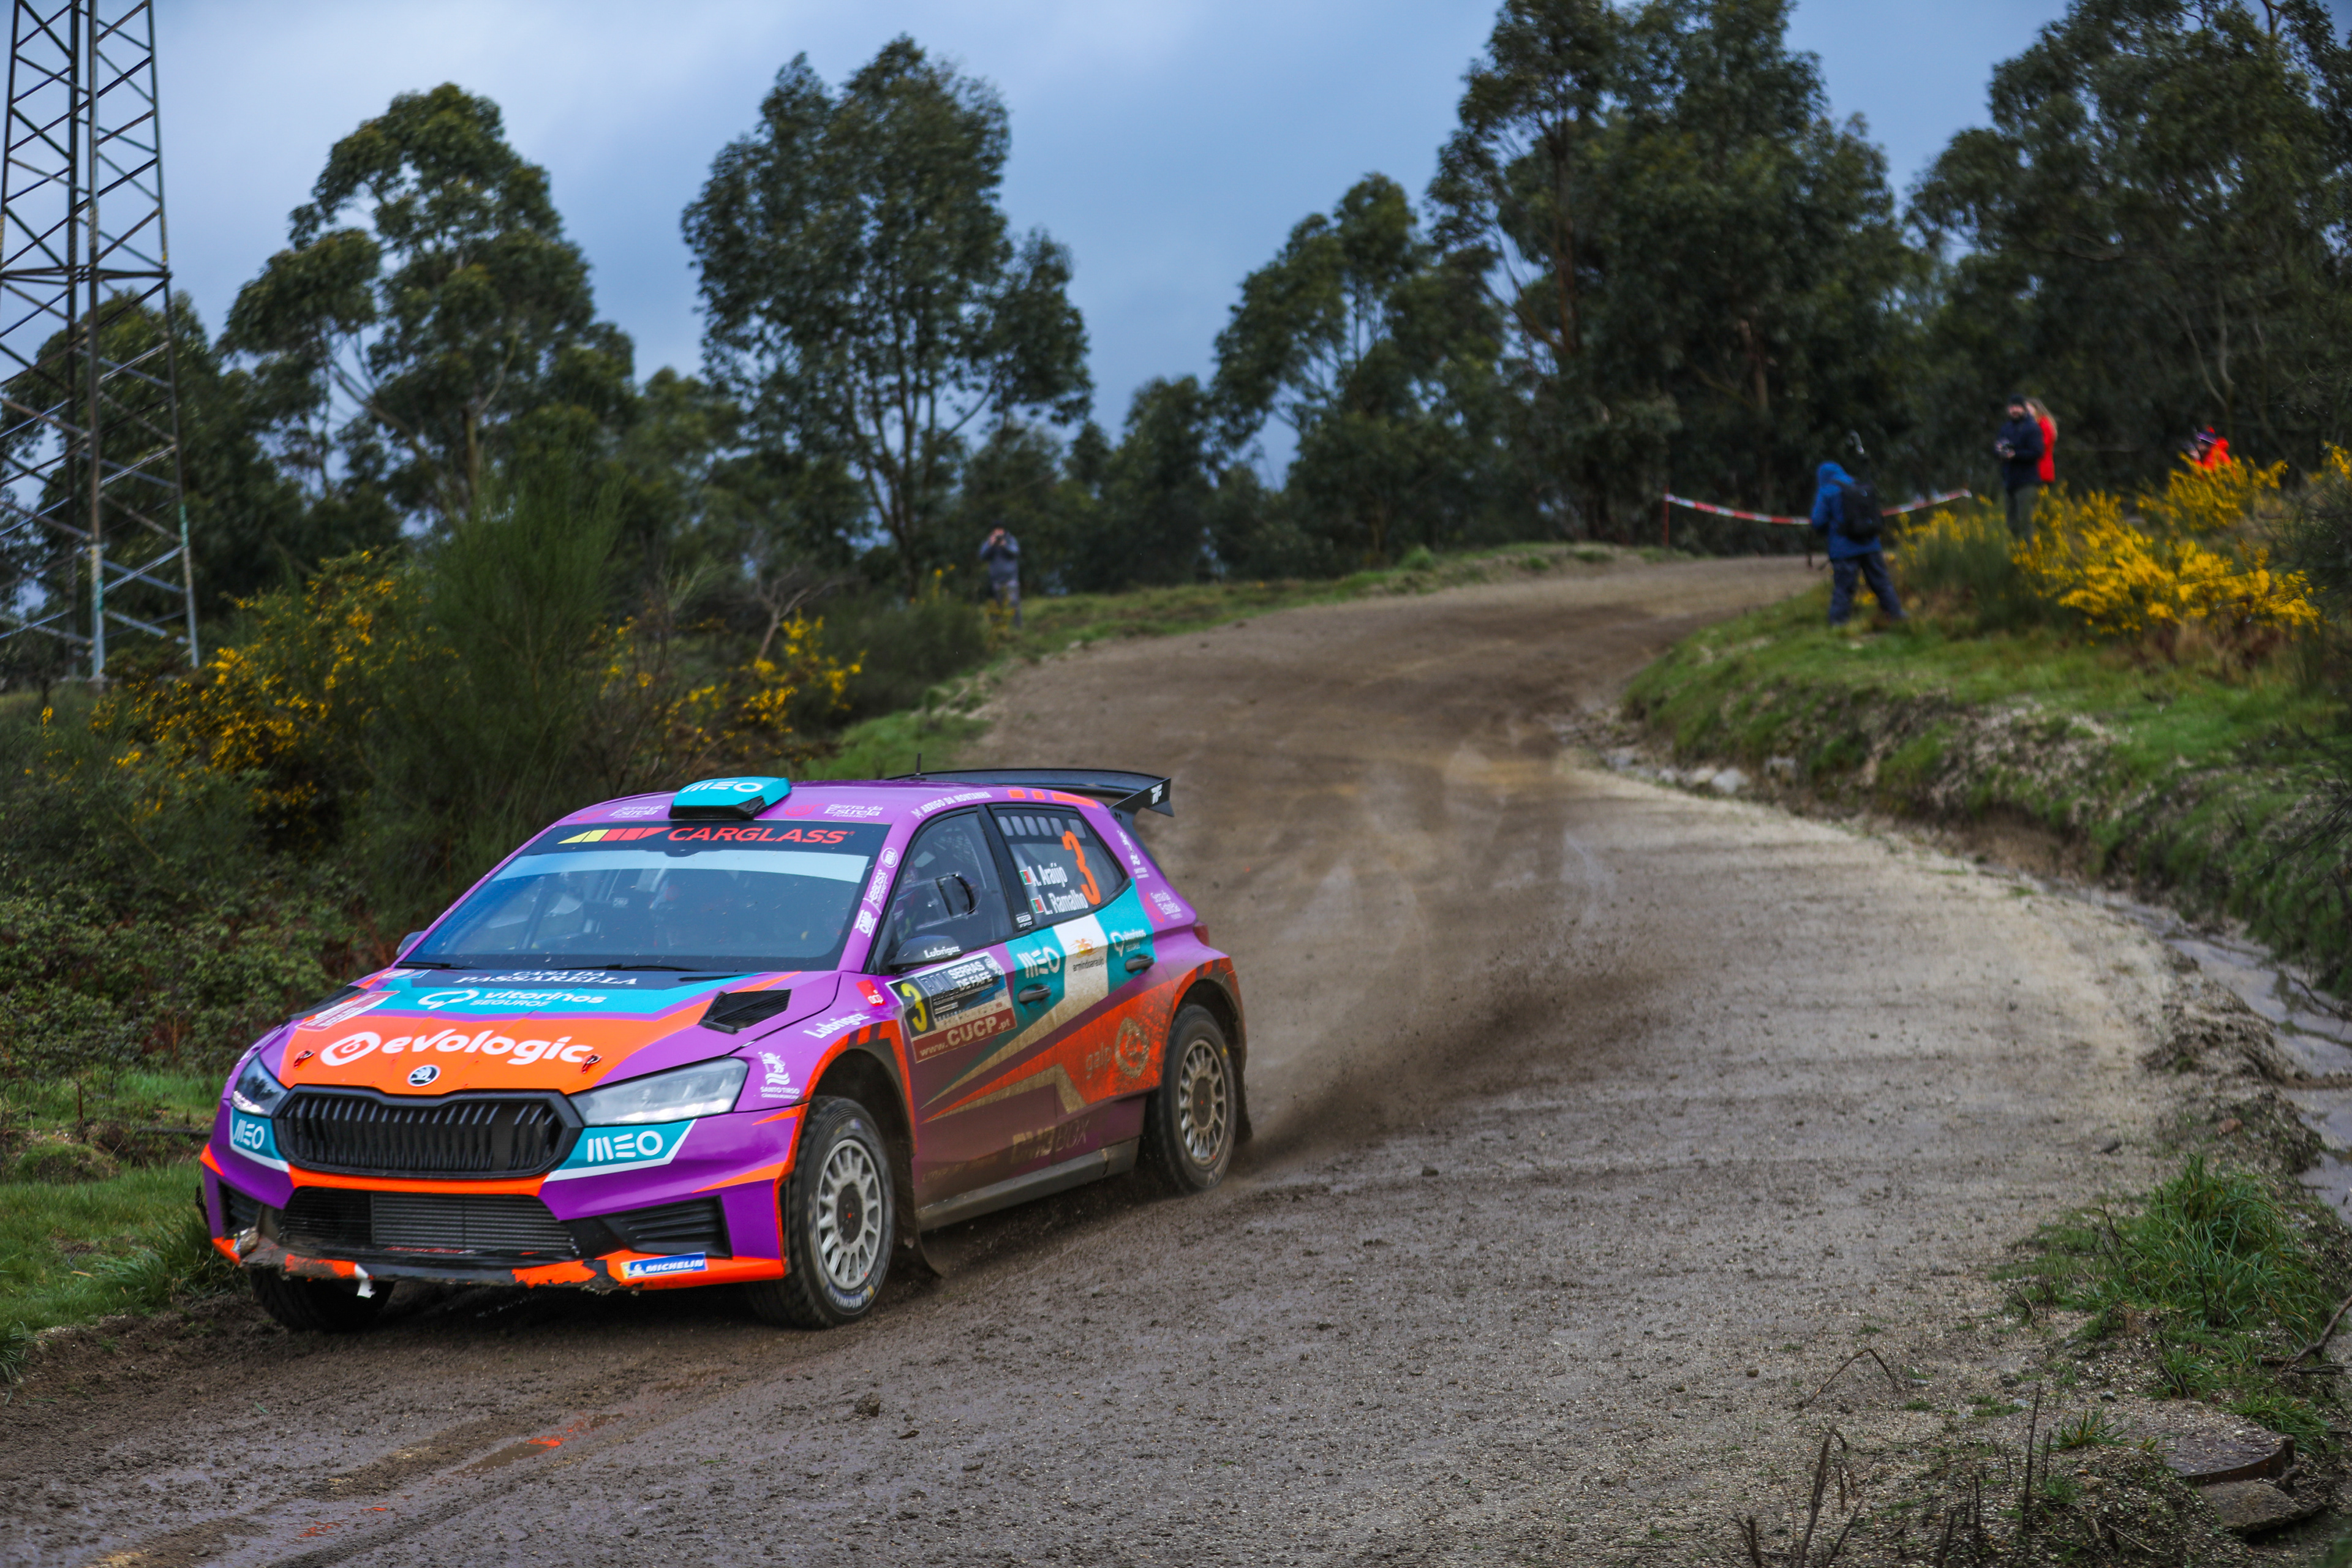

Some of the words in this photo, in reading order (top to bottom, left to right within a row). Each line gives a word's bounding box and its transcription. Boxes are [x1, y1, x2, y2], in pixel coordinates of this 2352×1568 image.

[681, 781, 763, 793] MEO
[609, 809, 658, 817] Estrela
[823, 808, 881, 816] Estrela
[920, 799, 946, 813] ABRIGO
[668, 827, 849, 844] CARGLASS
[1028, 866, 1042, 887] A.
[1038, 862, 1068, 888] Araújo
[1061, 831, 1101, 905] 3
[1039, 895, 1053, 915] L.
[1048, 889, 1088, 914] Ramalho
[859, 911, 874, 934] OMP
[924, 946, 961, 959] Lubrigaz
[1017, 947, 1061, 979] MEO
[453, 976, 638, 985] PASSARELLA
[948, 961, 986, 980] SERRAS
[956, 978, 971, 992] DE
[970, 971, 993, 988] FAFE
[484, 990, 607, 1003] vitorinos
[900, 983, 927, 1032] 3
[802, 1013, 870, 1039] Lubrigaz
[381, 1029, 593, 1065] evologic
[1086, 1042, 1112, 1080] galp
[233, 1119, 265, 1150] MEO
[587, 1130, 663, 1163] MEO
[646, 1259, 704, 1274] MICHELIN
